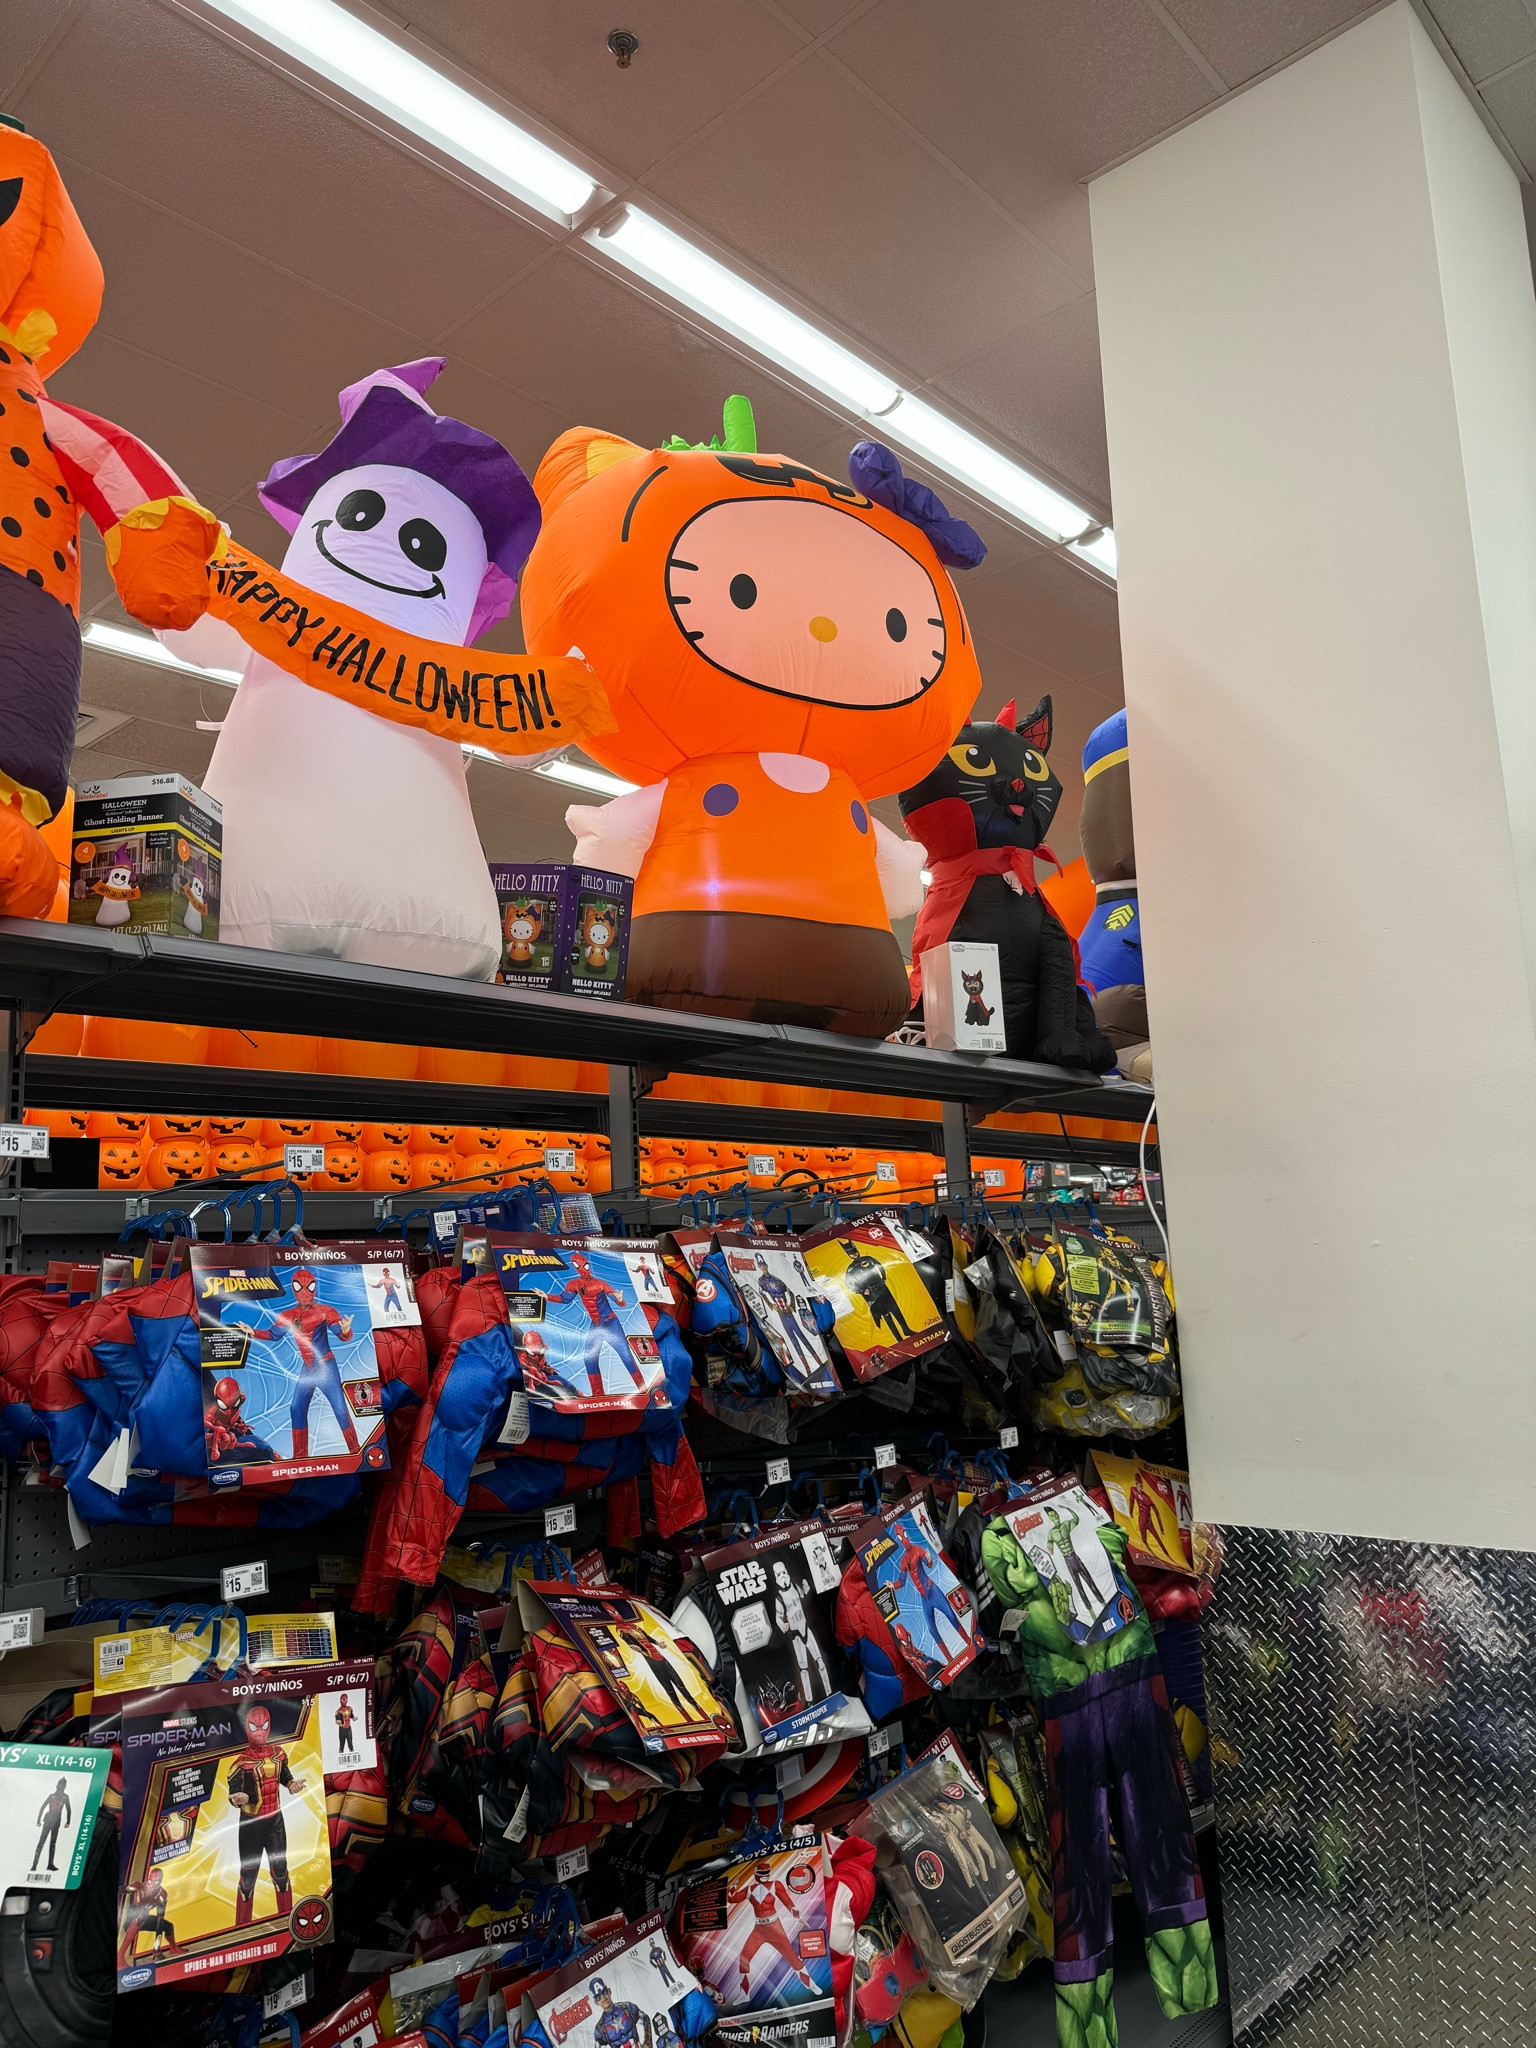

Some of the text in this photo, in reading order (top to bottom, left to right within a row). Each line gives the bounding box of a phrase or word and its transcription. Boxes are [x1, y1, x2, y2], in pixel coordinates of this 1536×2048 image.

[312, 626, 561, 733] HALLOWEEN!
[152, 777, 175, 786] $16.88
[102, 800, 147, 810] HALLOWEEN
[84, 813, 164, 827] Ghost Holding Banner
[494, 874, 560, 892] HELLO KITTY
[581, 874, 623, 895] HELLO KITTY
[153, 924, 168, 932] TALL
[506, 974, 526, 983] HELLO
[572, 979, 593, 988] HELLO
[1, 1136, 19, 1151] $15
[289, 1155, 303, 1168] $15
[549, 1155, 560, 1168] $15
[756, 1162, 764, 1174] $15
[851, 1214, 874, 1228] BOYS'
[869, 1228, 883, 1239] DC
[1092, 1234, 1114, 1247] BOYS'
[627, 1241, 638, 1249] S/P
[285, 1249, 404, 1261] BOYS'/NIÑOS S/P (6/7)
[502, 1253, 564, 1272] SPIDER-MAN
[230, 1269, 246, 1277] MARVEL
[202, 1276, 280, 1299] SPIDER-MAN
[913, 1329, 945, 1348] BATMAN
[578, 1400, 632, 1410] SPIDER-MAN
[272, 1464, 339, 1477] SPIDER-MAN
[769, 1470, 778, 1482] $15
[1143, 1464, 1161, 1475] BOYS'
[546, 1517, 558, 1532] $15
[1013, 1512, 1044, 1540] AVENGERS
[755, 1532, 791, 1550] BOYS'/NIÑOS
[800, 1524, 809, 1534] S/P
[864, 1537, 896, 1573] SPIDER-MAN
[717, 1560, 766, 1590] STAR
[226, 1578, 241, 1593] $15
[717, 1574, 768, 1606] WARS
[548, 1602, 602, 1613] SPIDER-MAN
[1102, 1618, 1116, 1633] HULK
[232, 1672, 370, 1697] BOYS'/NIÑOS S/P (6/7)
[301, 1699, 315, 1707] $15
[163, 1716, 198, 1729] MARVEL STUDIOS
[791, 1705, 828, 1730] STORMTROOPER
[127, 1722, 232, 1748] SPIDER-MAN
[940, 1735, 950, 1749] (8)
[157, 1742, 206, 1757] No Way Home
[36, 1754, 51, 1765] XL
[54, 1755, 96, 1770] (14-16)
[72, 1814, 93, 1876] BOYS' XL (14-16)
[772, 1843, 787, 1853] XS
[790, 1836, 815, 1851] (4/5)
[558, 1862, 570, 1877] $15
[484, 1918, 519, 1940] BOYS'
[951, 1917, 993, 1953] GHOSTBUSTERS
[584, 1914, 662, 1970] BOYS'/NIÑOS S/P (6/7)
[184, 1942, 277, 1974] SPIDER-MAN INTEGRATED SUIT
[629, 1949, 639, 1958] $15
[338, 2006, 372, 2037] M/M (8)
[549, 1995, 593, 2045] AVENGERS
[309, 2021, 326, 2035] VENOM
[760, 2020, 810, 2041] RANGERS
